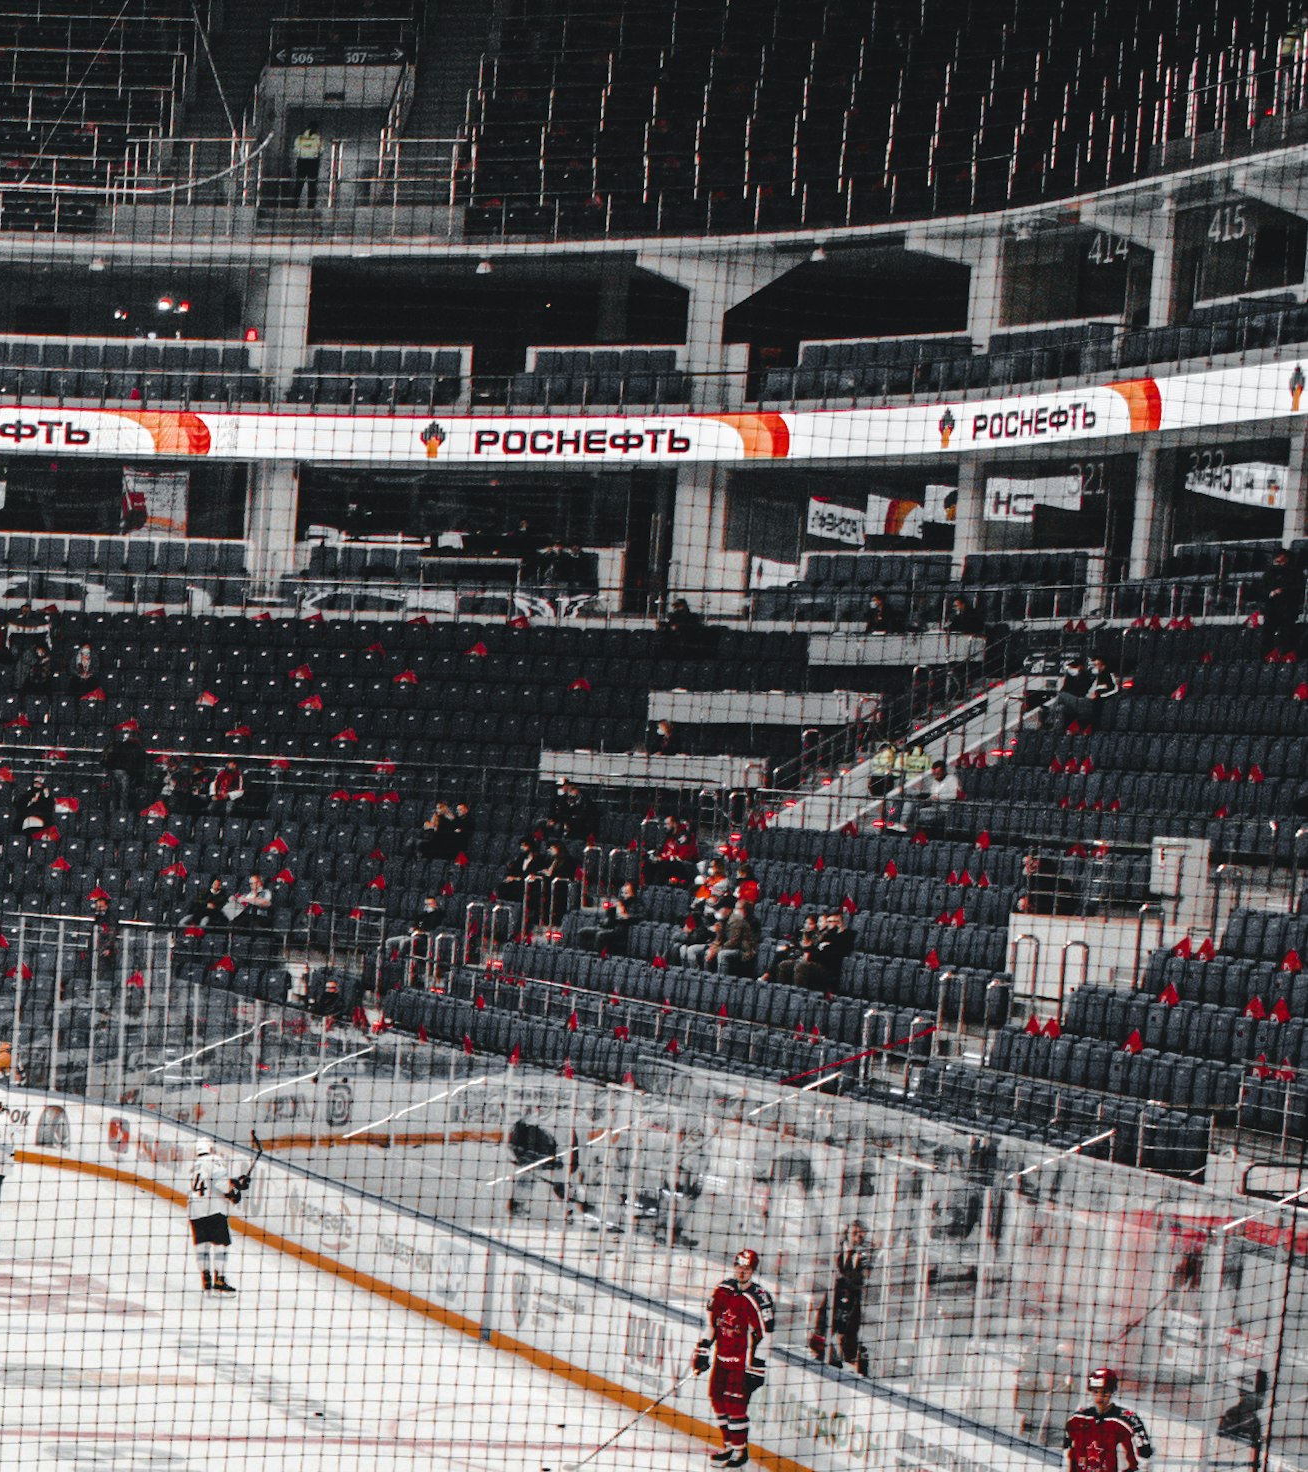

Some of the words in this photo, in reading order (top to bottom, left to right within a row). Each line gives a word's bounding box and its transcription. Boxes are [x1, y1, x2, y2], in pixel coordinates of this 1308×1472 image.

[1208, 205, 1246, 242] 415
[972, 401, 1097, 441] РОСНЕФТЬ
[474, 428, 691, 455] РОСНЕФТЬ
